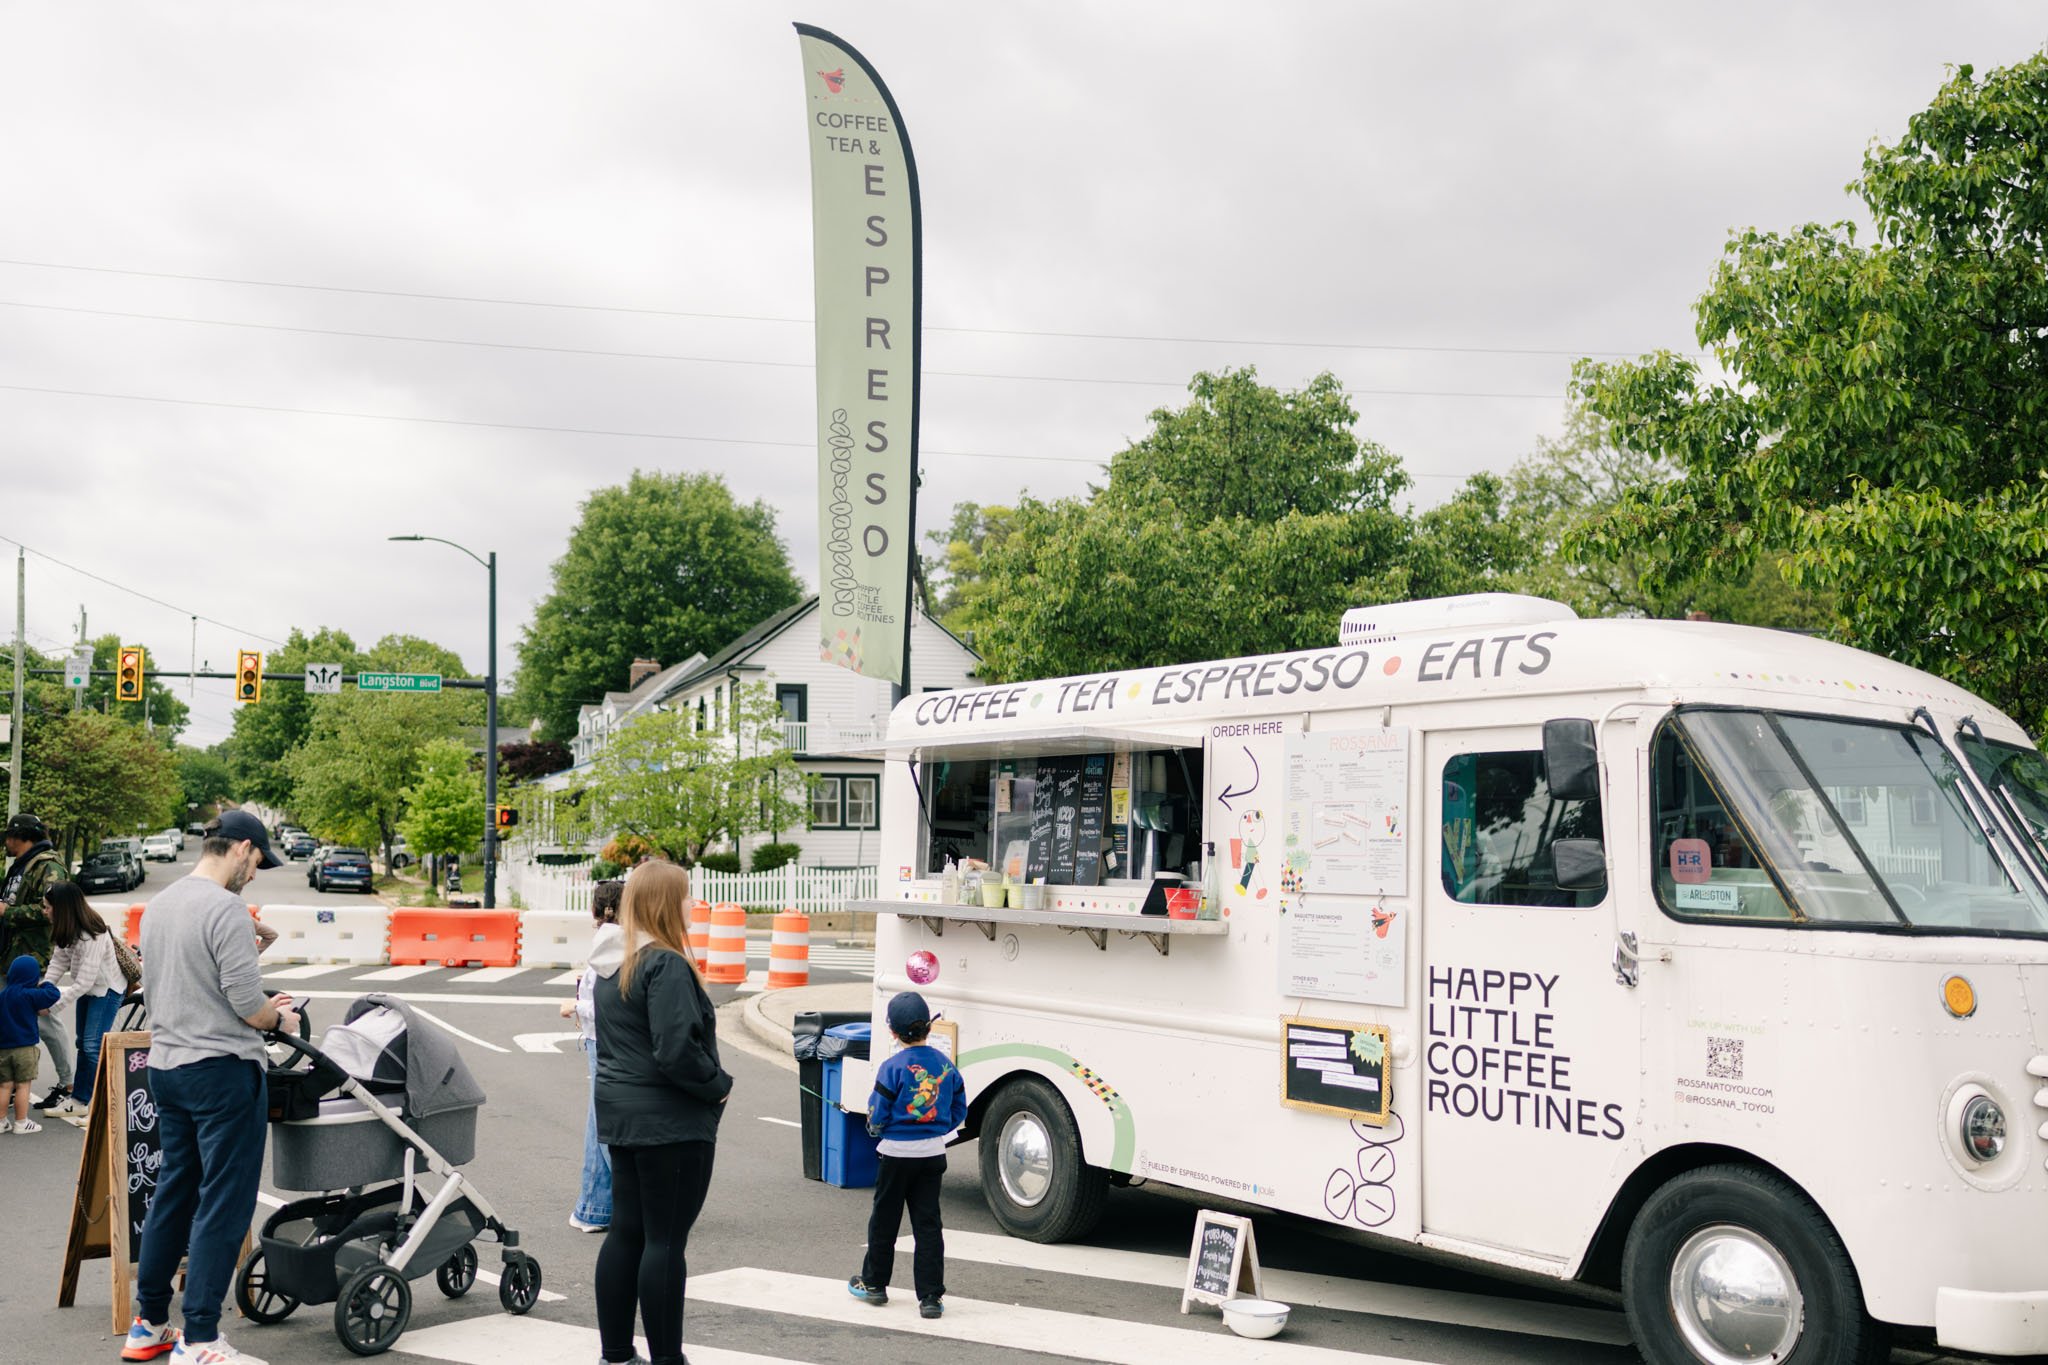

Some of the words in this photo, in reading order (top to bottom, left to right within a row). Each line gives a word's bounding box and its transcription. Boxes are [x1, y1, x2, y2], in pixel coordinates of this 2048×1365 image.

[816, 112, 888, 132] COFFEE
[826, 136, 864, 154] TEA
[869, 140, 880, 156] &
[863, 164, 891, 557] ESPRESSO
[361, 674, 414, 689] Langston
[420, 679, 438, 688] Blvd
[916, 687, 1028, 726] COFFEE
[1057, 678, 1120, 714] TEA
[1152, 650, 1370, 705] ESPRESSO
[1418, 632, 1558, 682] EATS
[1212, 724, 1250, 738] ORDER
[1253, 722, 1282, 735] HERE
[1329, 734, 1398, 752] ROSSANA
[1430, 966, 1560, 1008] HAPPY
[1430, 1003, 1554, 1048] LITTLE
[1427, 1042, 1571, 1092] COFFEE
[1677, 1078, 1774, 1098] ROSSANATOYOU.COM
[1428, 1079, 1625, 1140] ROUTINES
[1686, 1094, 1775, 1114] @ROSSANA_TOYOU
[1148, 1161, 1169, 1172] FUELED
[1170, 1166, 1178, 1174] BY
[1179, 1168, 1210, 1182] ESPRESSO,
[1211, 1176, 1242, 1190] POWERED
[1242, 1182, 1250, 1192] BY
